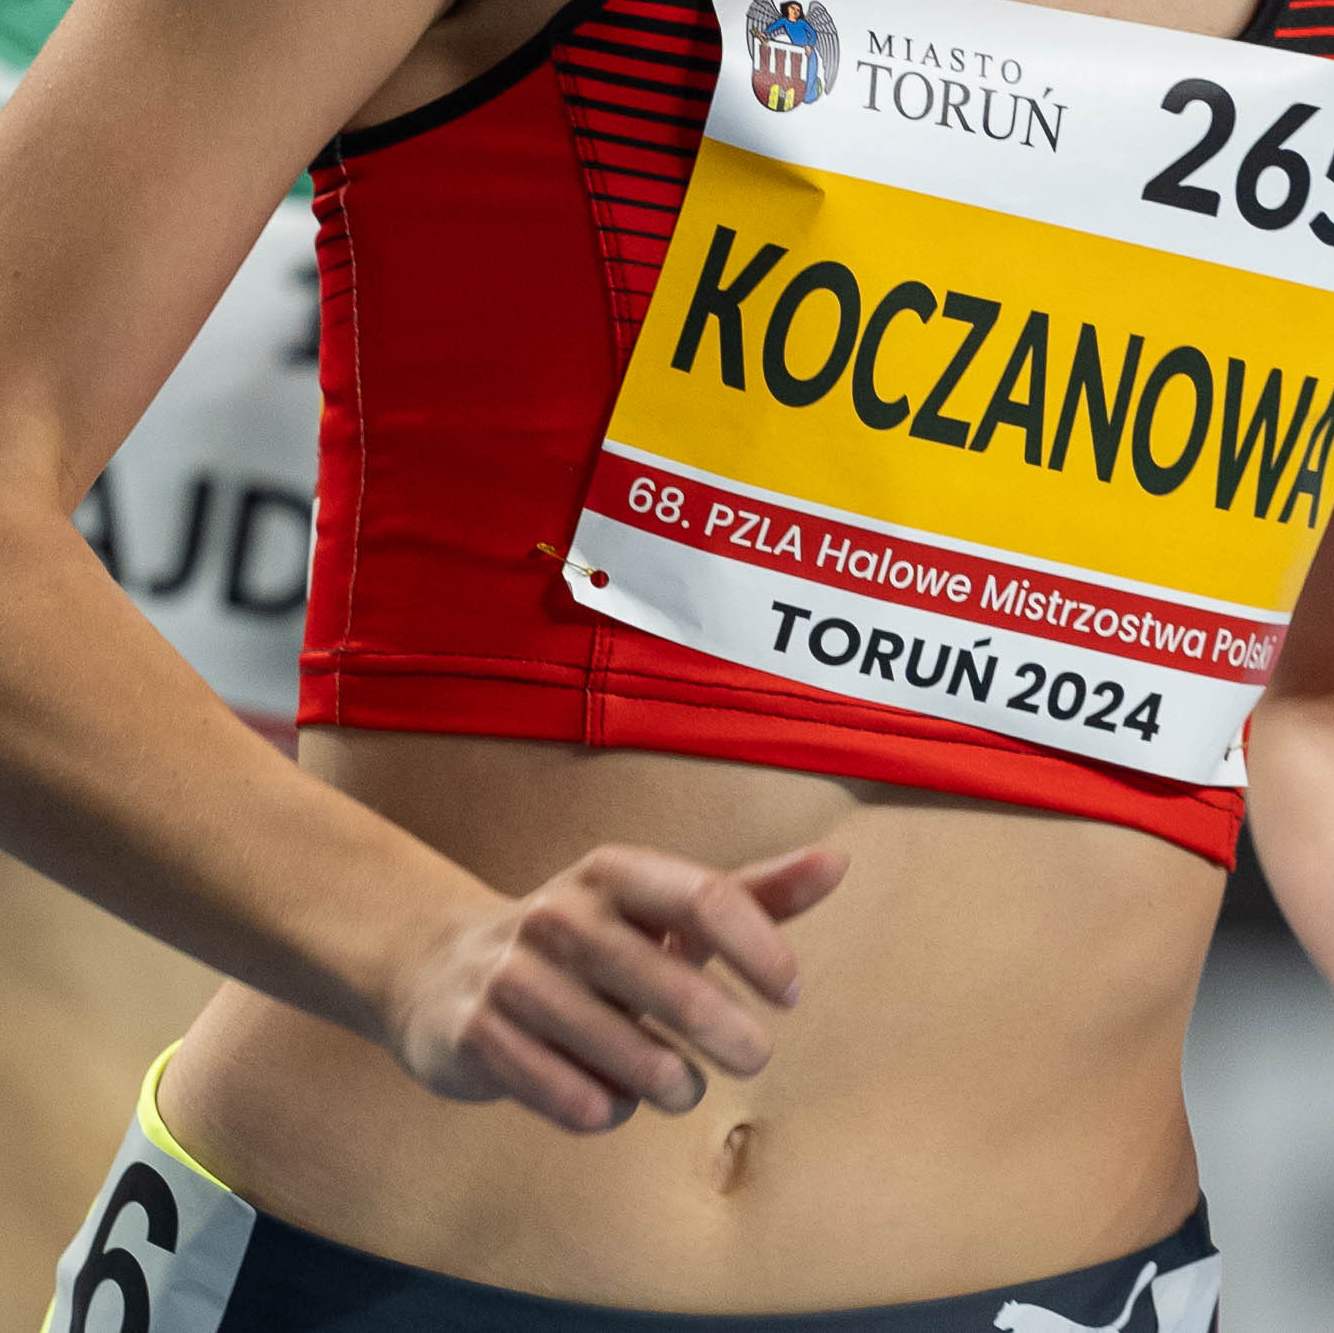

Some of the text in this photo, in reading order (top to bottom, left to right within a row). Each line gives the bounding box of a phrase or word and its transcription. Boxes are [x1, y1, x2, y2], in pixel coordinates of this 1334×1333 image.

[856, 60, 1070, 154] TORUŃ
[866, 29, 1024, 86] MIASTO
[627, 476, 691, 530] 68.
[703, 502, 804, 562] PZLA
[816, 533, 973, 603] Halowe
[979, 574, 1208, 660] Mistrzostwa
[770, 600, 1164, 743] TORUŃ 2024
[69, 1160, 180, 1333] 6
